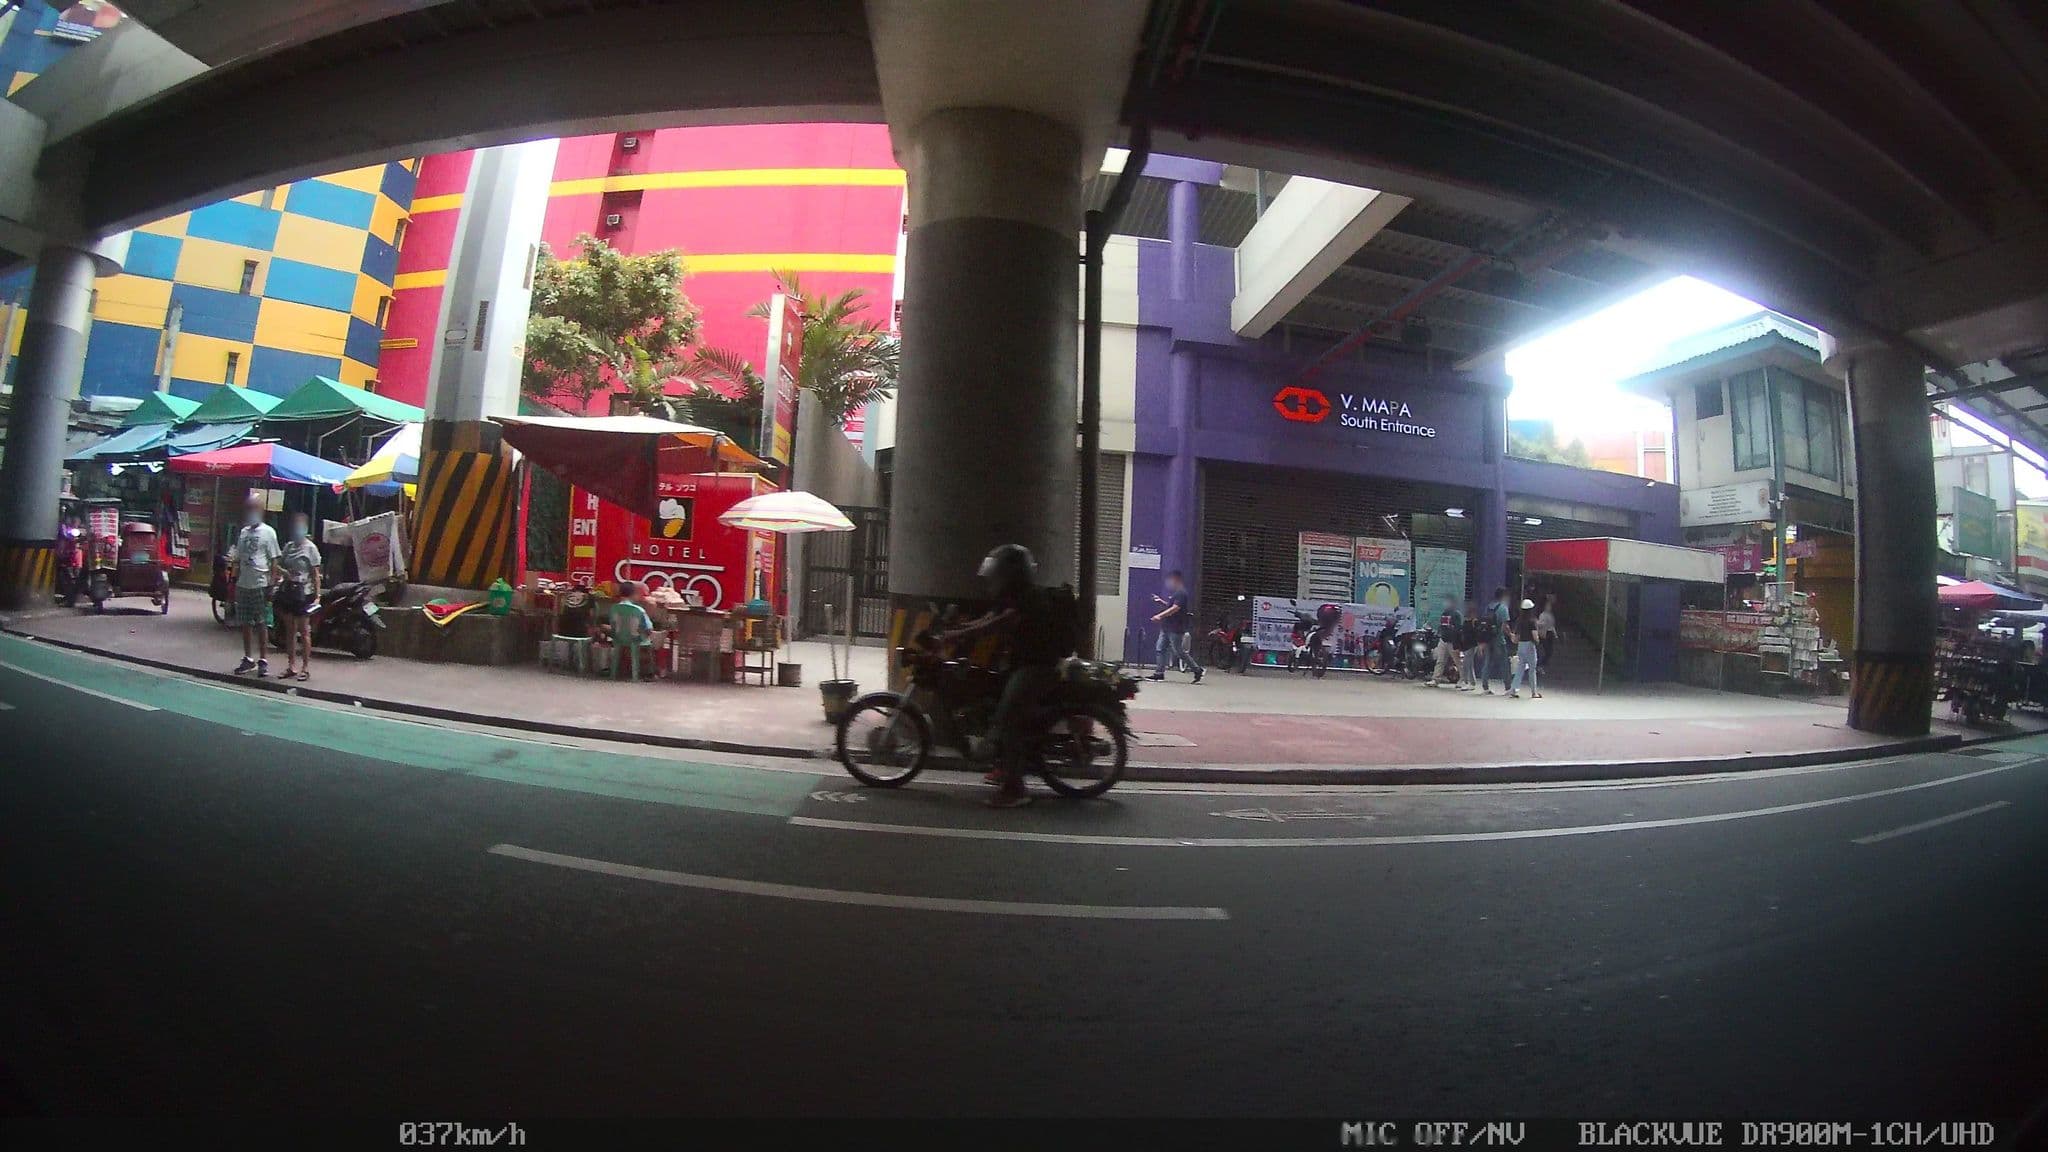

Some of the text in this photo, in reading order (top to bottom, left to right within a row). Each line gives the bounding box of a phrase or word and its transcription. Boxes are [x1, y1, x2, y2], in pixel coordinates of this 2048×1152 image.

[1340, 394, 1412, 418] V. MAPA
[1340, 413, 1436, 438] South Entrance
[632, 544, 707, 559] HOTEL
[1360, 562, 1378, 577] NO
